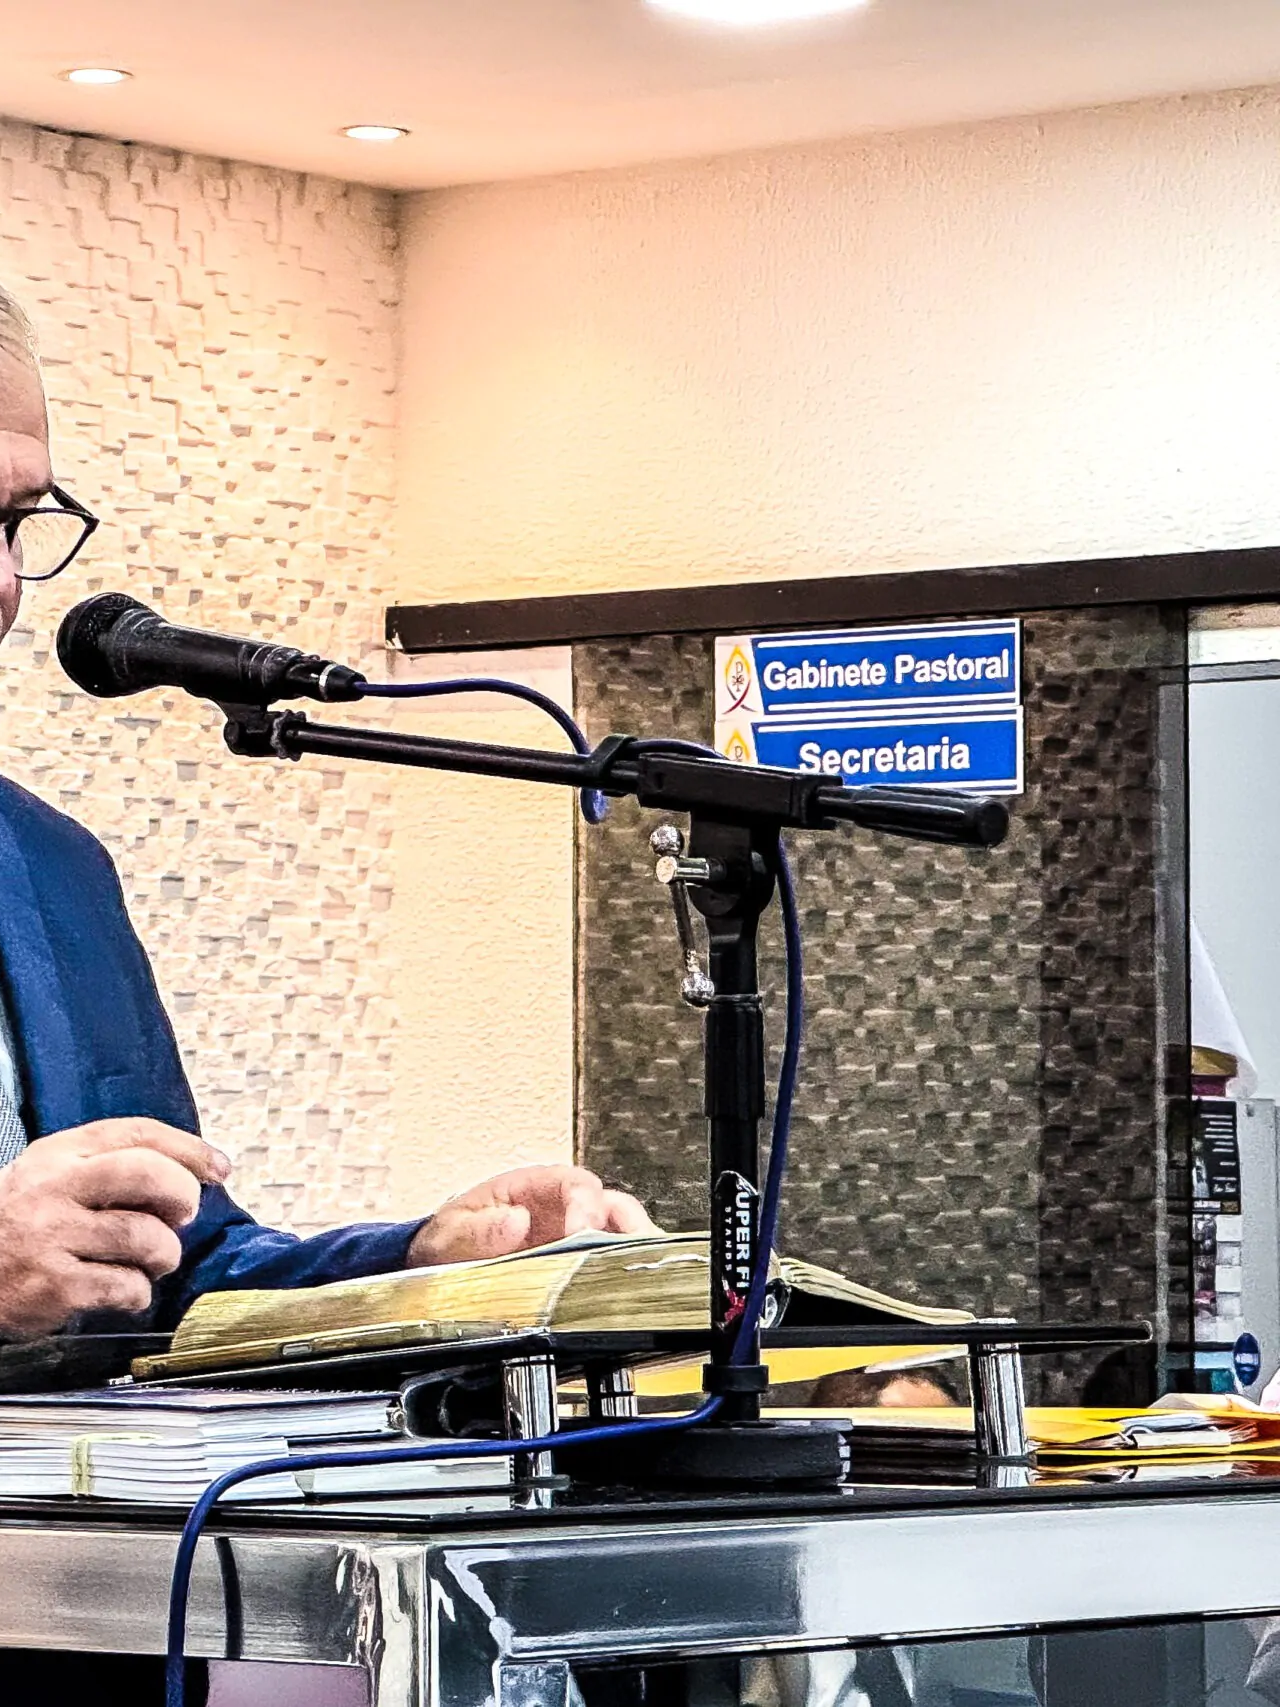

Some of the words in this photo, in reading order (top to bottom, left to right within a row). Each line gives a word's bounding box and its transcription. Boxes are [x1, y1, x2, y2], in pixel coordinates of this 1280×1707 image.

[763, 659, 886, 691] Gabinete
[894, 648, 1009, 684] Pastoral
[799, 736, 970, 775] Secretaria
[724, 1206, 733, 1271] STANDS
